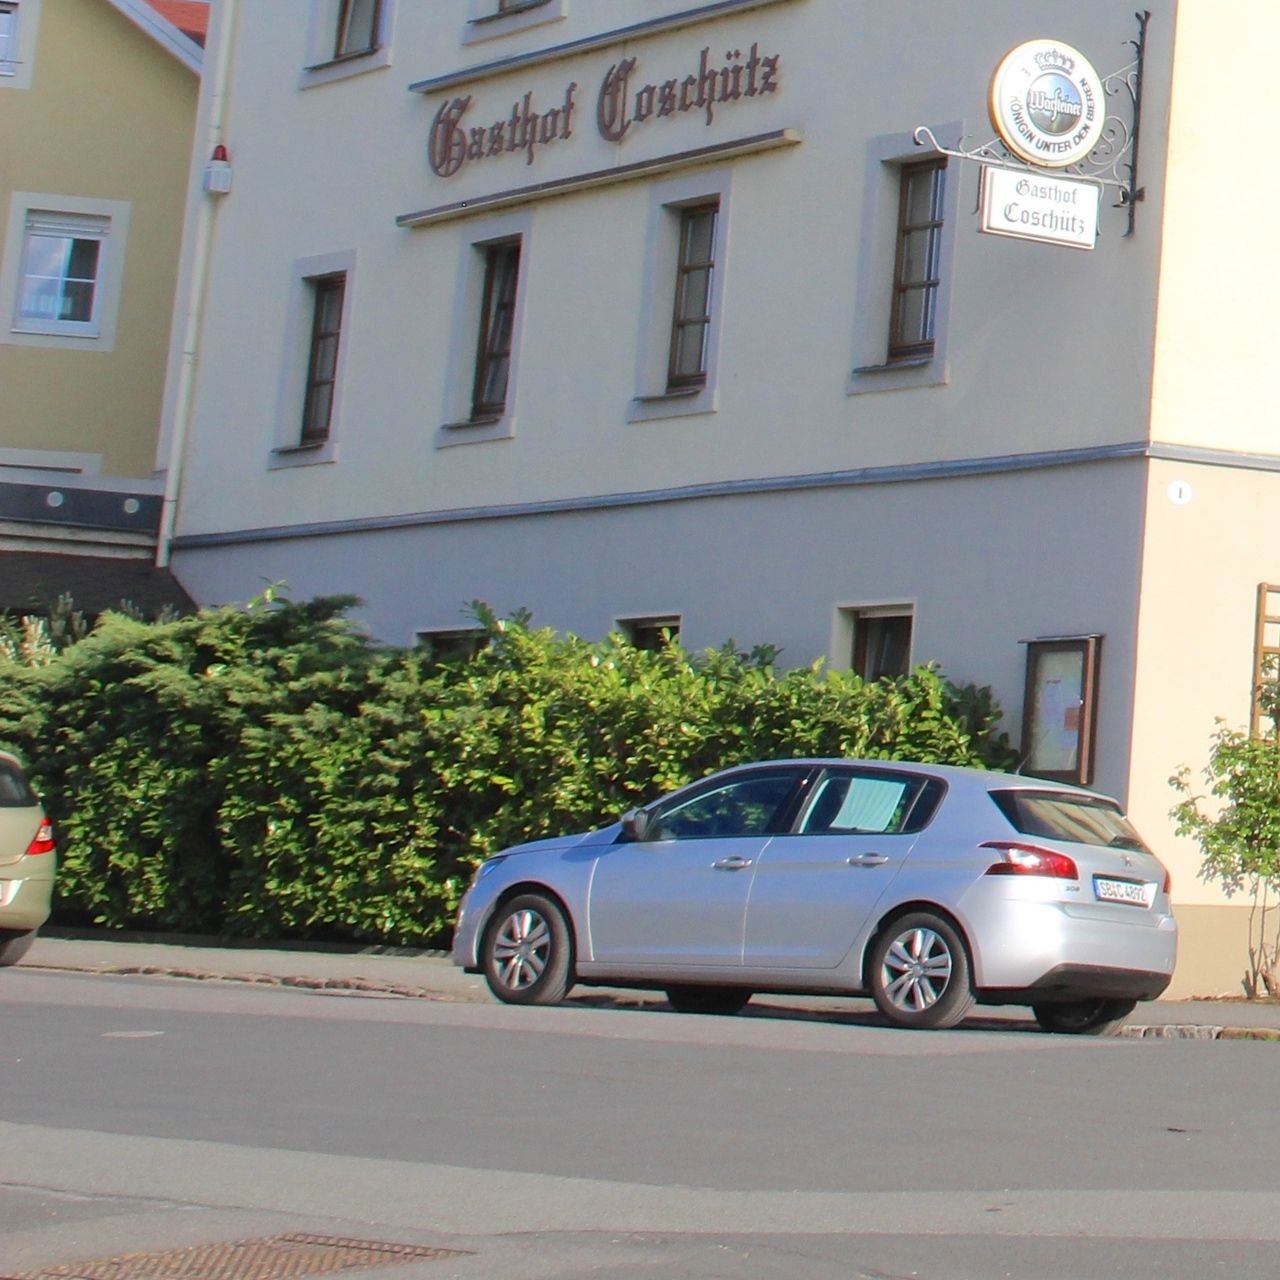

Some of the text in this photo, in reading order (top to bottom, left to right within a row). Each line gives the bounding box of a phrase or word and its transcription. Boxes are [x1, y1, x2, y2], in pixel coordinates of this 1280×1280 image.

[428, 42, 780, 178] Gasthof Coschütz
[1010, 77, 1095, 153] KÖNIGIN UNTER DEN BIEREN
[1003, 201, 1085, 238] Coschütz
[1015, 178, 1078, 205] Gasthof
